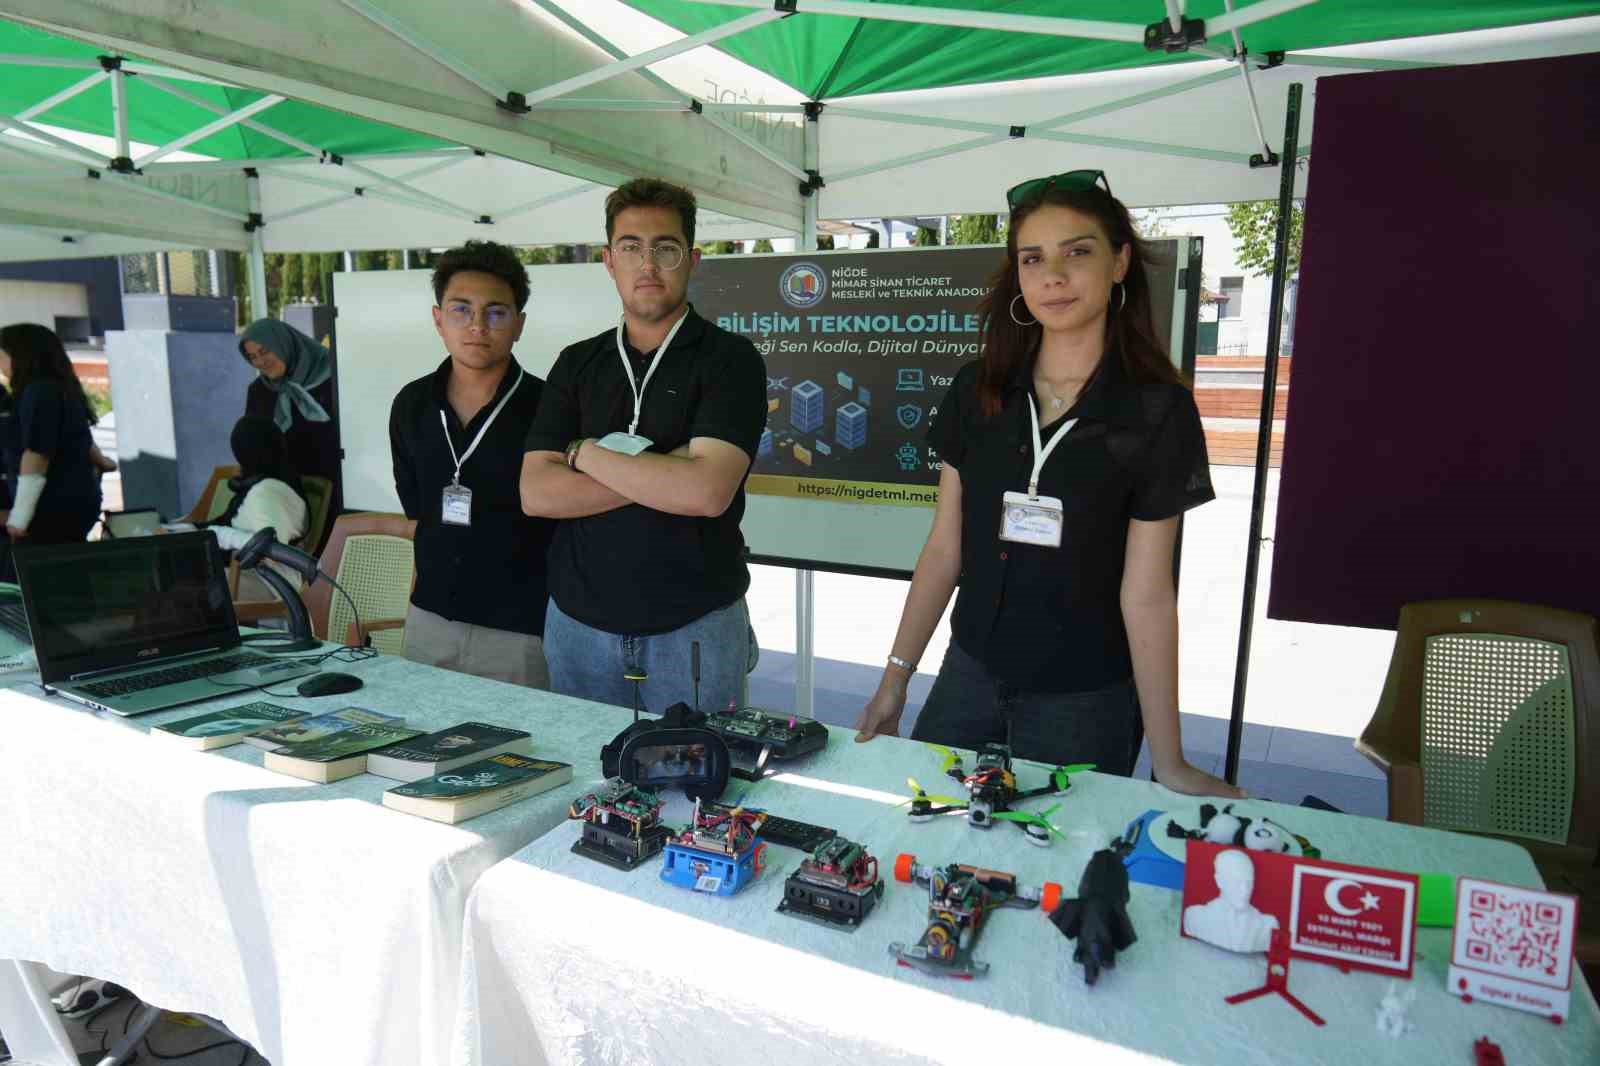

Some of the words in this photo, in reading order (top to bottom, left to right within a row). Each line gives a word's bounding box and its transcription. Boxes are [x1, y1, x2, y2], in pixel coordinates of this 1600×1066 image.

[831, 266, 868, 277] NİĞDE
[831, 278, 867, 289] MİMAR
[869, 276, 903, 288] SİNAN
[905, 274, 953, 287] TİCARET
[831, 288, 876, 299] MESLEKİ
[892, 286, 934, 298] TEKNİK
[716, 311, 801, 338] BİLİŞİM
[806, 308, 991, 333] TEKNOLOJİLE
[779, 340, 808, 353] Sen
[812, 339, 863, 356] Kodla,
[867, 338, 919, 357] Dijital
[929, 375, 954, 387] Yaz
